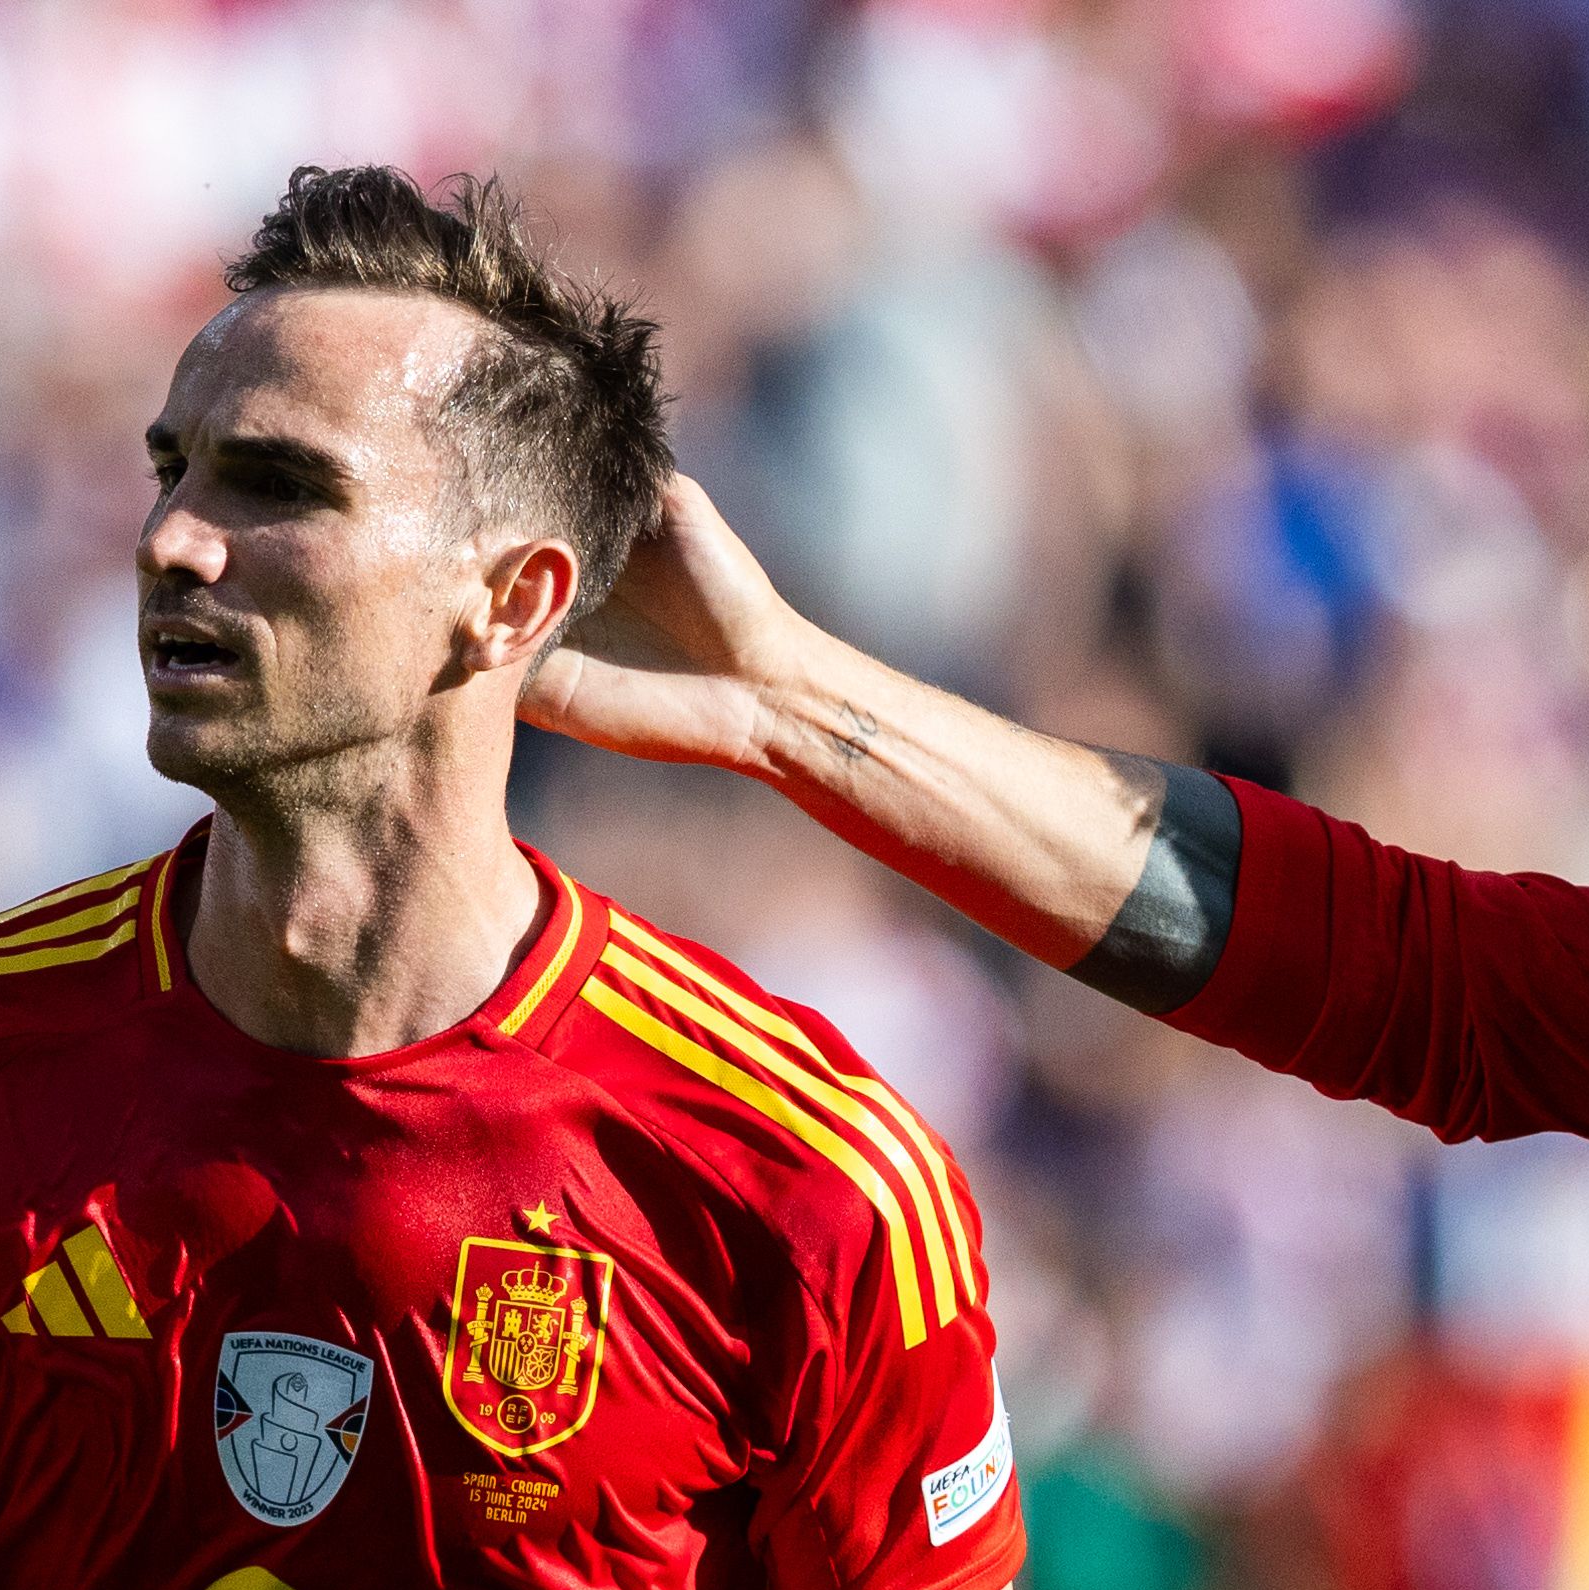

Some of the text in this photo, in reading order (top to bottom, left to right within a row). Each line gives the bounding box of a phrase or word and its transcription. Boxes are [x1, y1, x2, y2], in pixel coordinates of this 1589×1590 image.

[231, 1338, 367, 1373] UEFA NATIONS LEAGUE
[479, 1403, 557, 1425] 19 09
[463, 1471, 497, 1489] SPAIN
[511, 1479, 560, 1498] CROATIA
[929, 1464, 970, 1495] UEFA
[242, 1489, 314, 1519] WINNER 2023
[469, 1488, 548, 1511] 15 JUNE 2024
[485, 1506, 528, 1524] BERLIN
